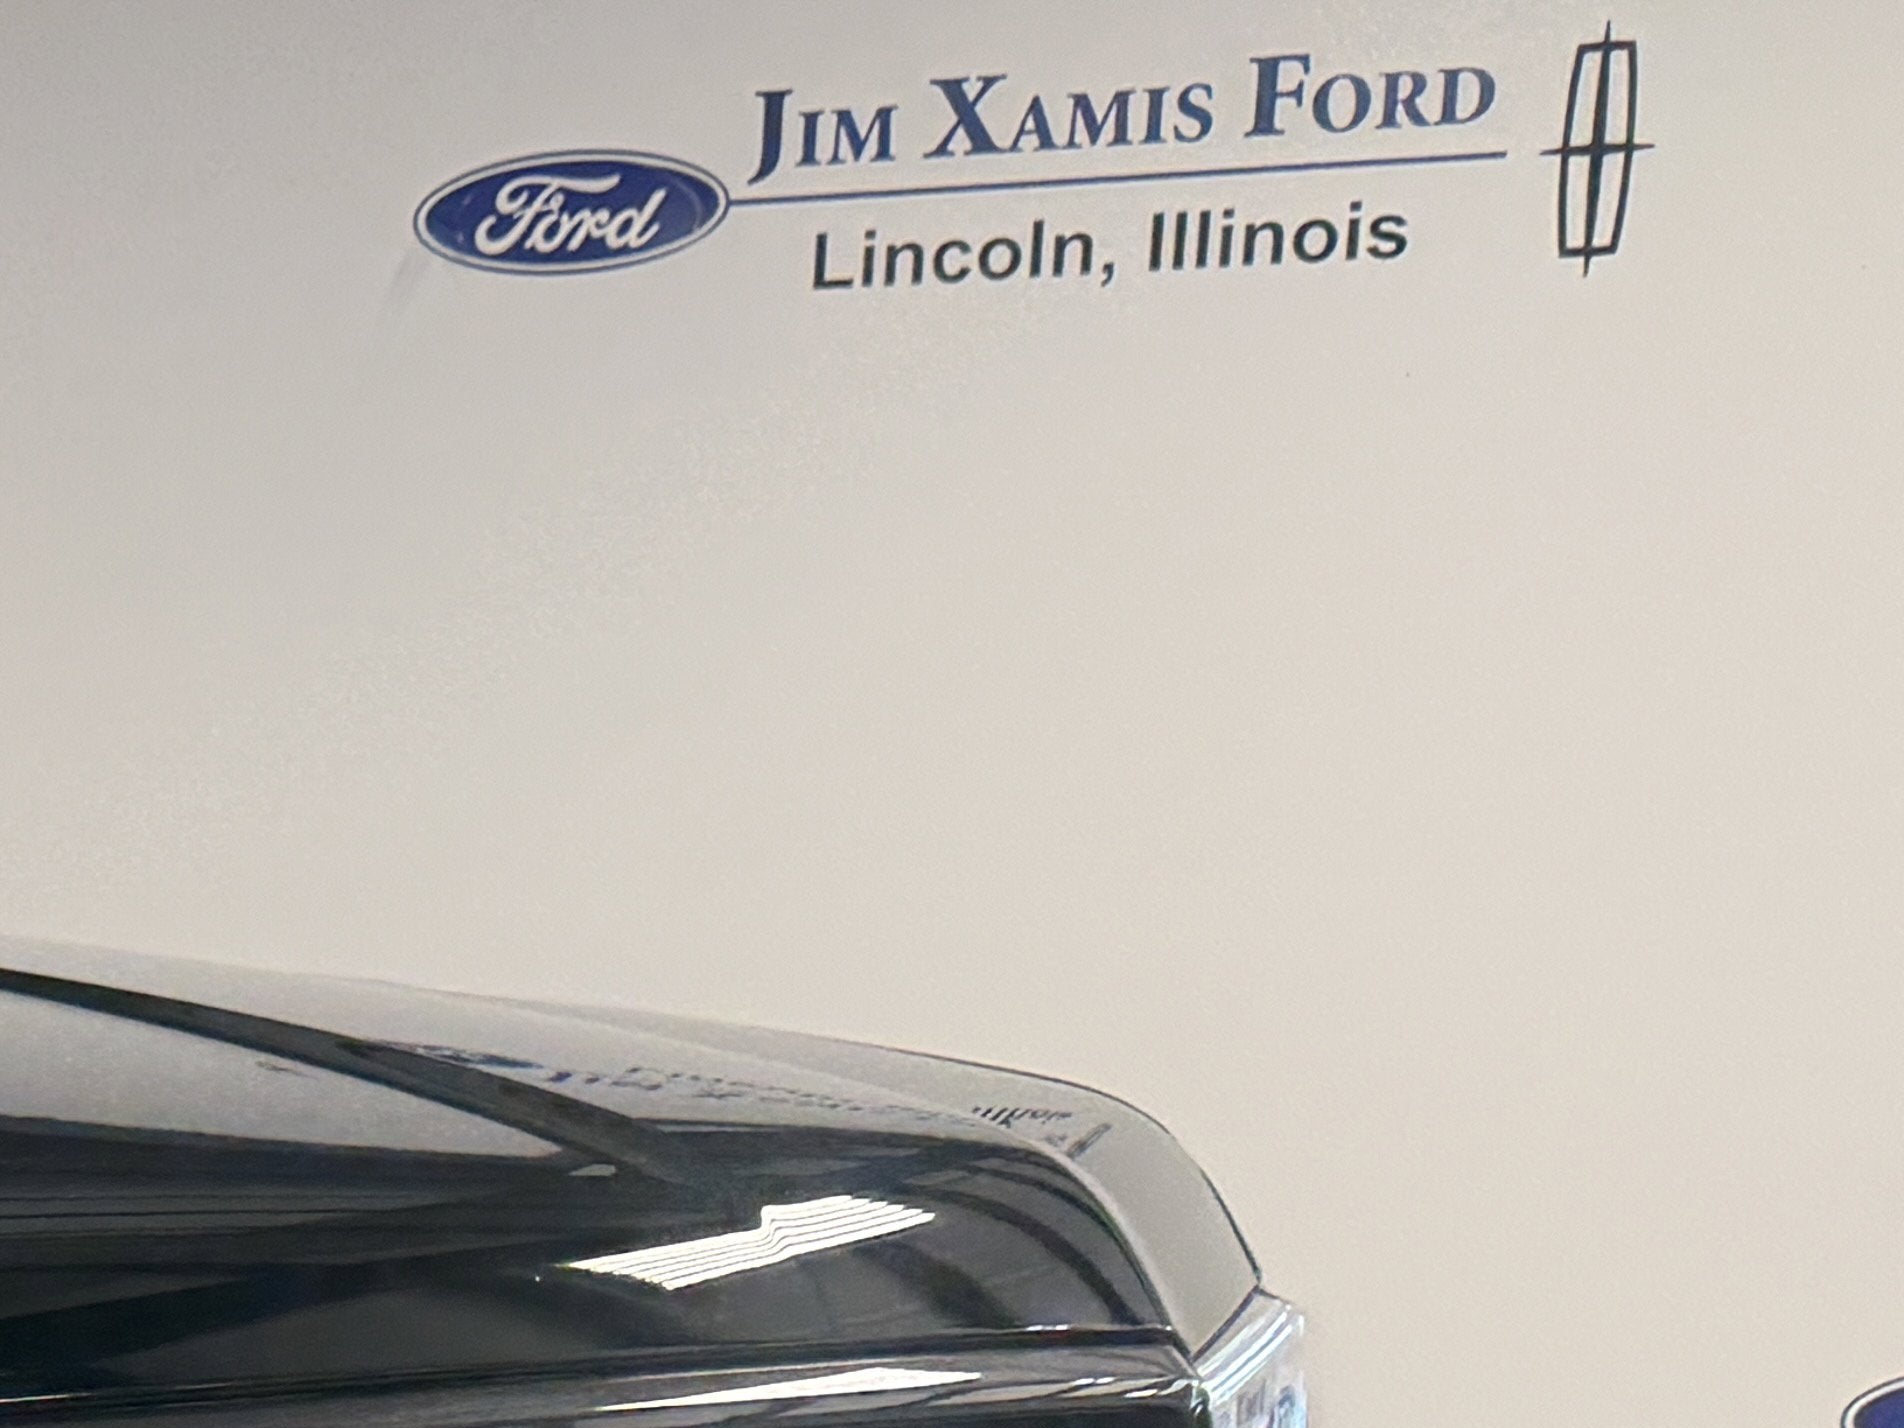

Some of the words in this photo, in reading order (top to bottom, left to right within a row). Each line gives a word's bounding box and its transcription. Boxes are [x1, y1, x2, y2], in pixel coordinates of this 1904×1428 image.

[748, 88, 899, 185] JIM
[922, 73, 1213, 158] XAMIS
[1243, 53, 1496, 138] FORD
[474, 173, 668, 255] Ford
[812, 219, 1115, 290] Lincoln,
[1147, 200, 1409, 272] Illinois
